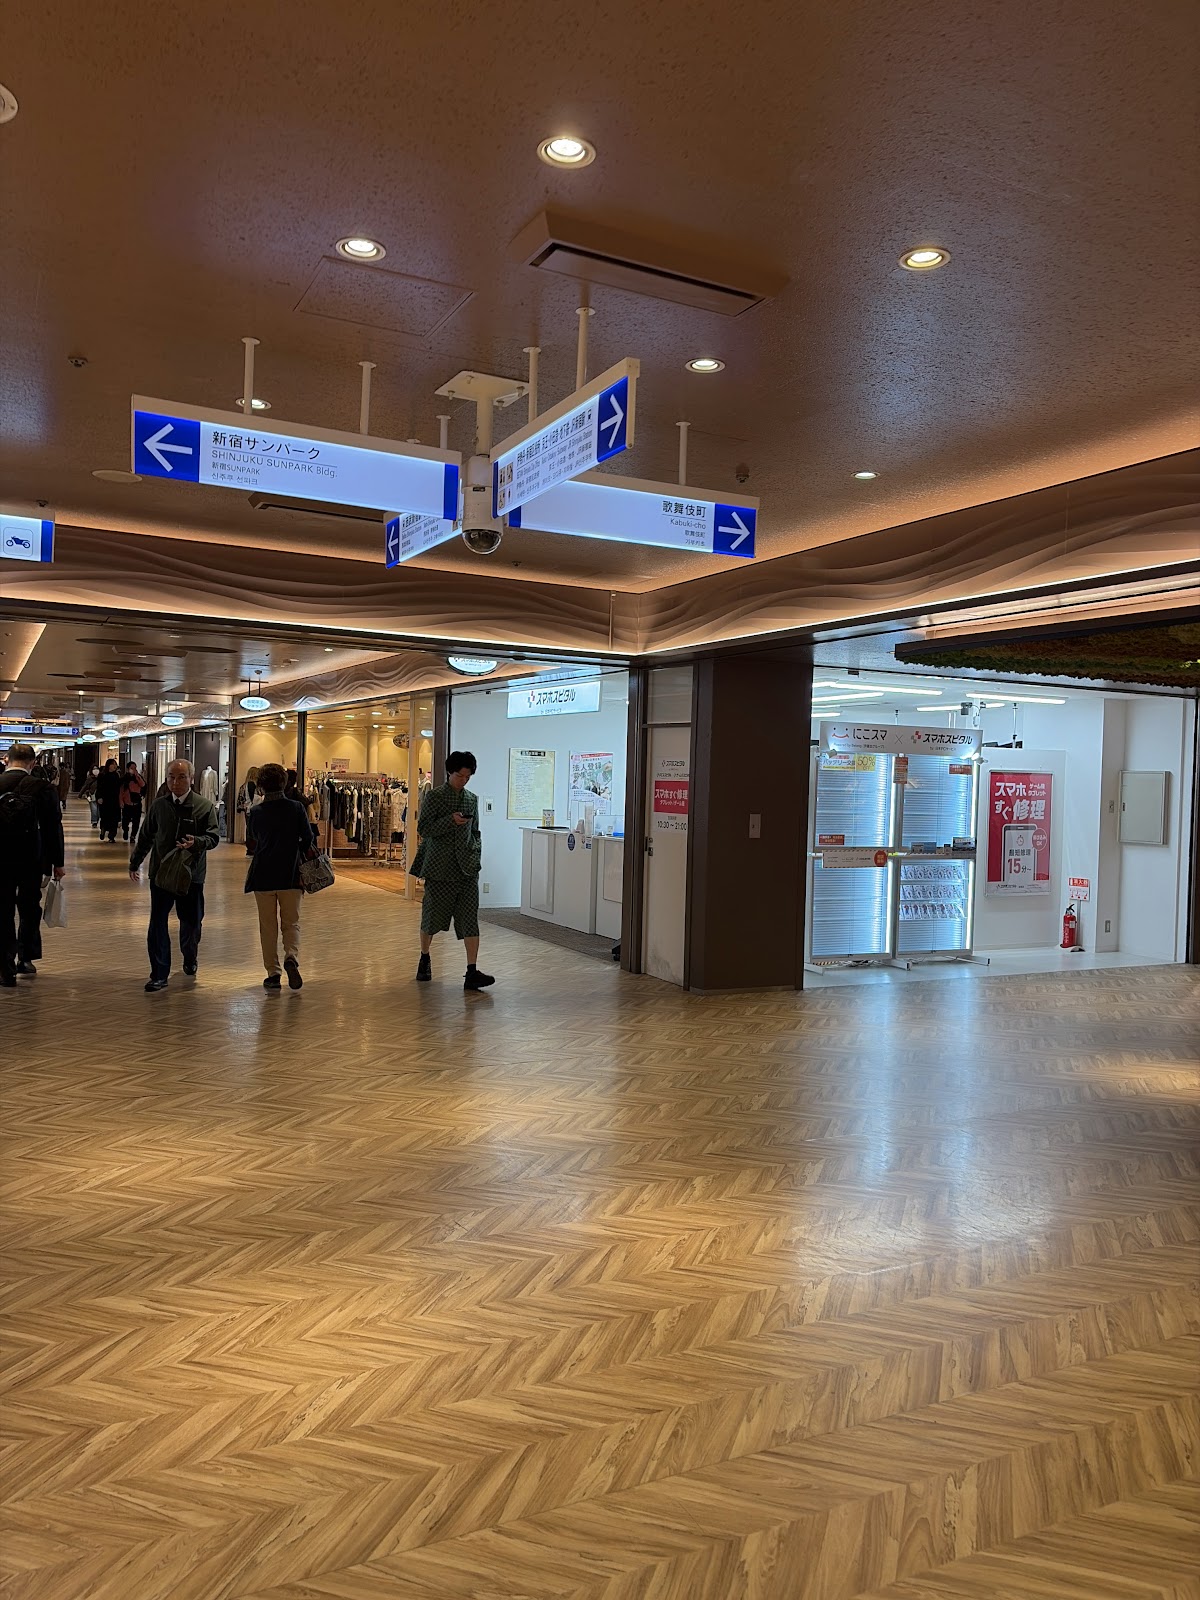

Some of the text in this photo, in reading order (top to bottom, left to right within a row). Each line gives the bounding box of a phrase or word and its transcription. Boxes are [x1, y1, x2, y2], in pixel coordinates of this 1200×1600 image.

[212, 431, 320, 460] 新宿サンパーク
[211, 450, 338, 479] SHINJUKU SUNPARK Bldg.
[212, 461, 261, 475] 新宿SUNPARK
[662, 501, 707, 518] 歌舞伎町
[670, 518, 706, 530] Kabuki-cho
[536, 689, 576, 705] スマホスピタル
[853, 729, 887, 741] にこスマ
[923, 733, 973, 745] スマホスピタル
[655, 789, 689, 800] スマホすぐ修理
[995, 782, 1027, 797] スマホ
[995, 799, 1046, 821] すぐ修理
